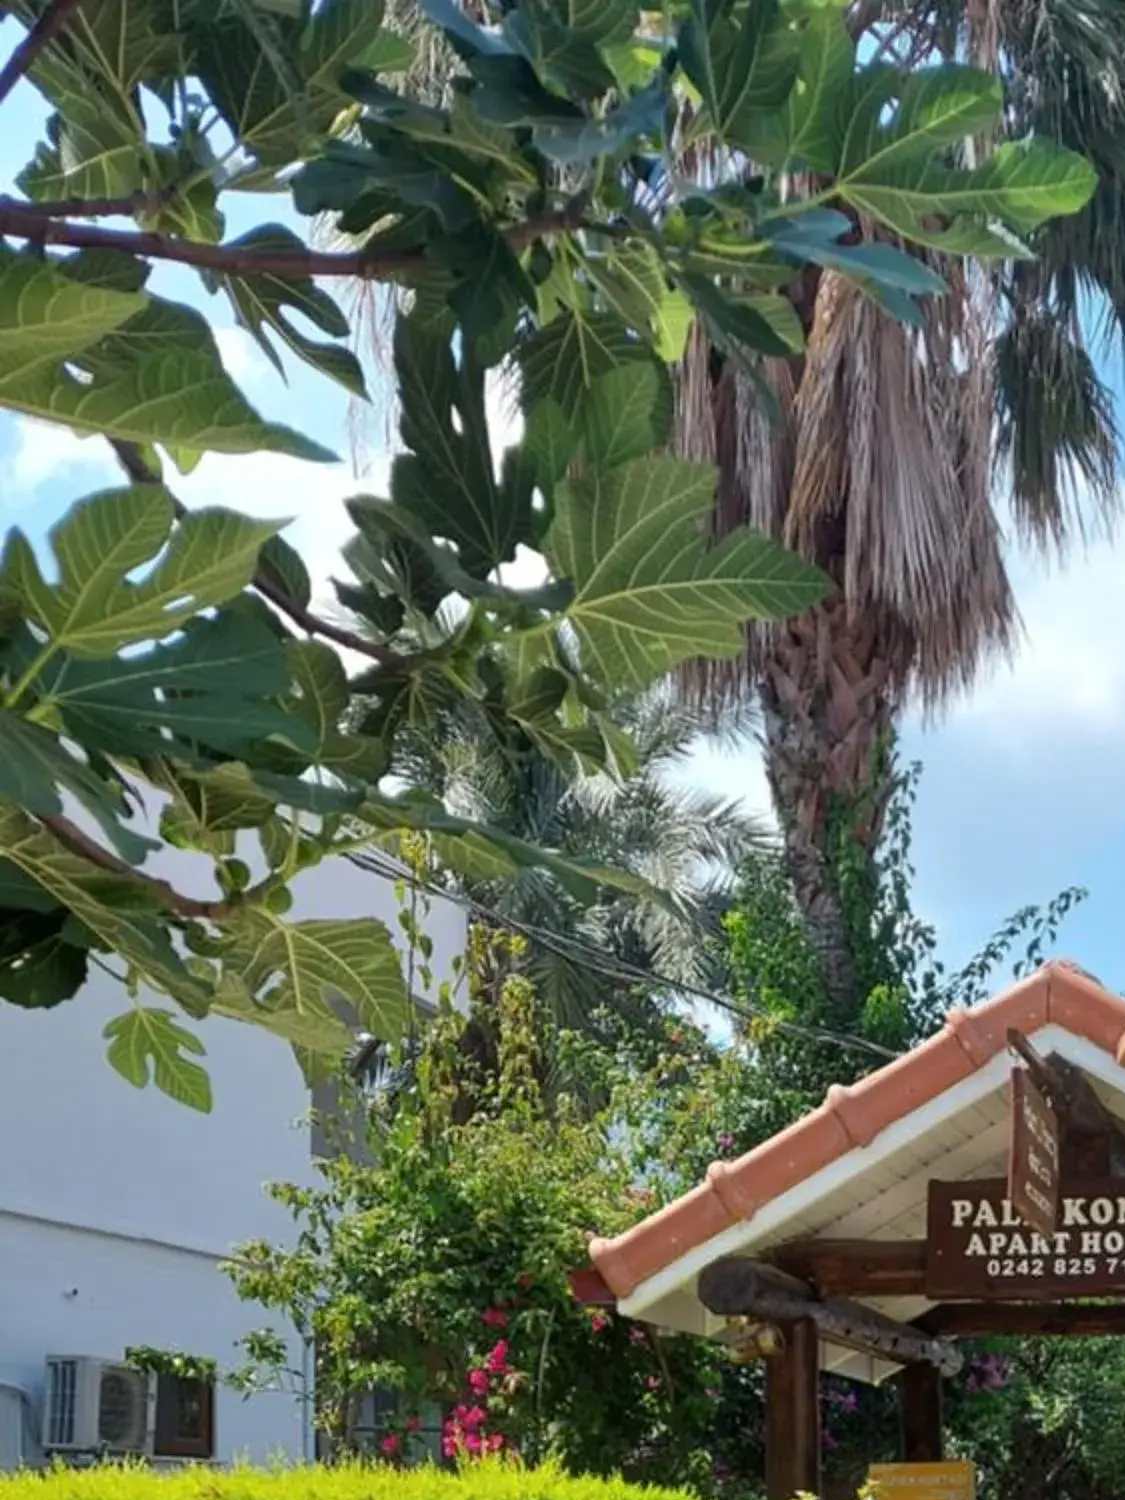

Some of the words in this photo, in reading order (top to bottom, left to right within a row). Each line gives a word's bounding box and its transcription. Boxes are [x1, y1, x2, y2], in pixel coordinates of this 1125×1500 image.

[951, 1199, 1040, 1226] PAL
[964, 1232, 1070, 1256] APART
[986, 1258, 1044, 1276] 0242
[1053, 1258, 1096, 1275] 825
